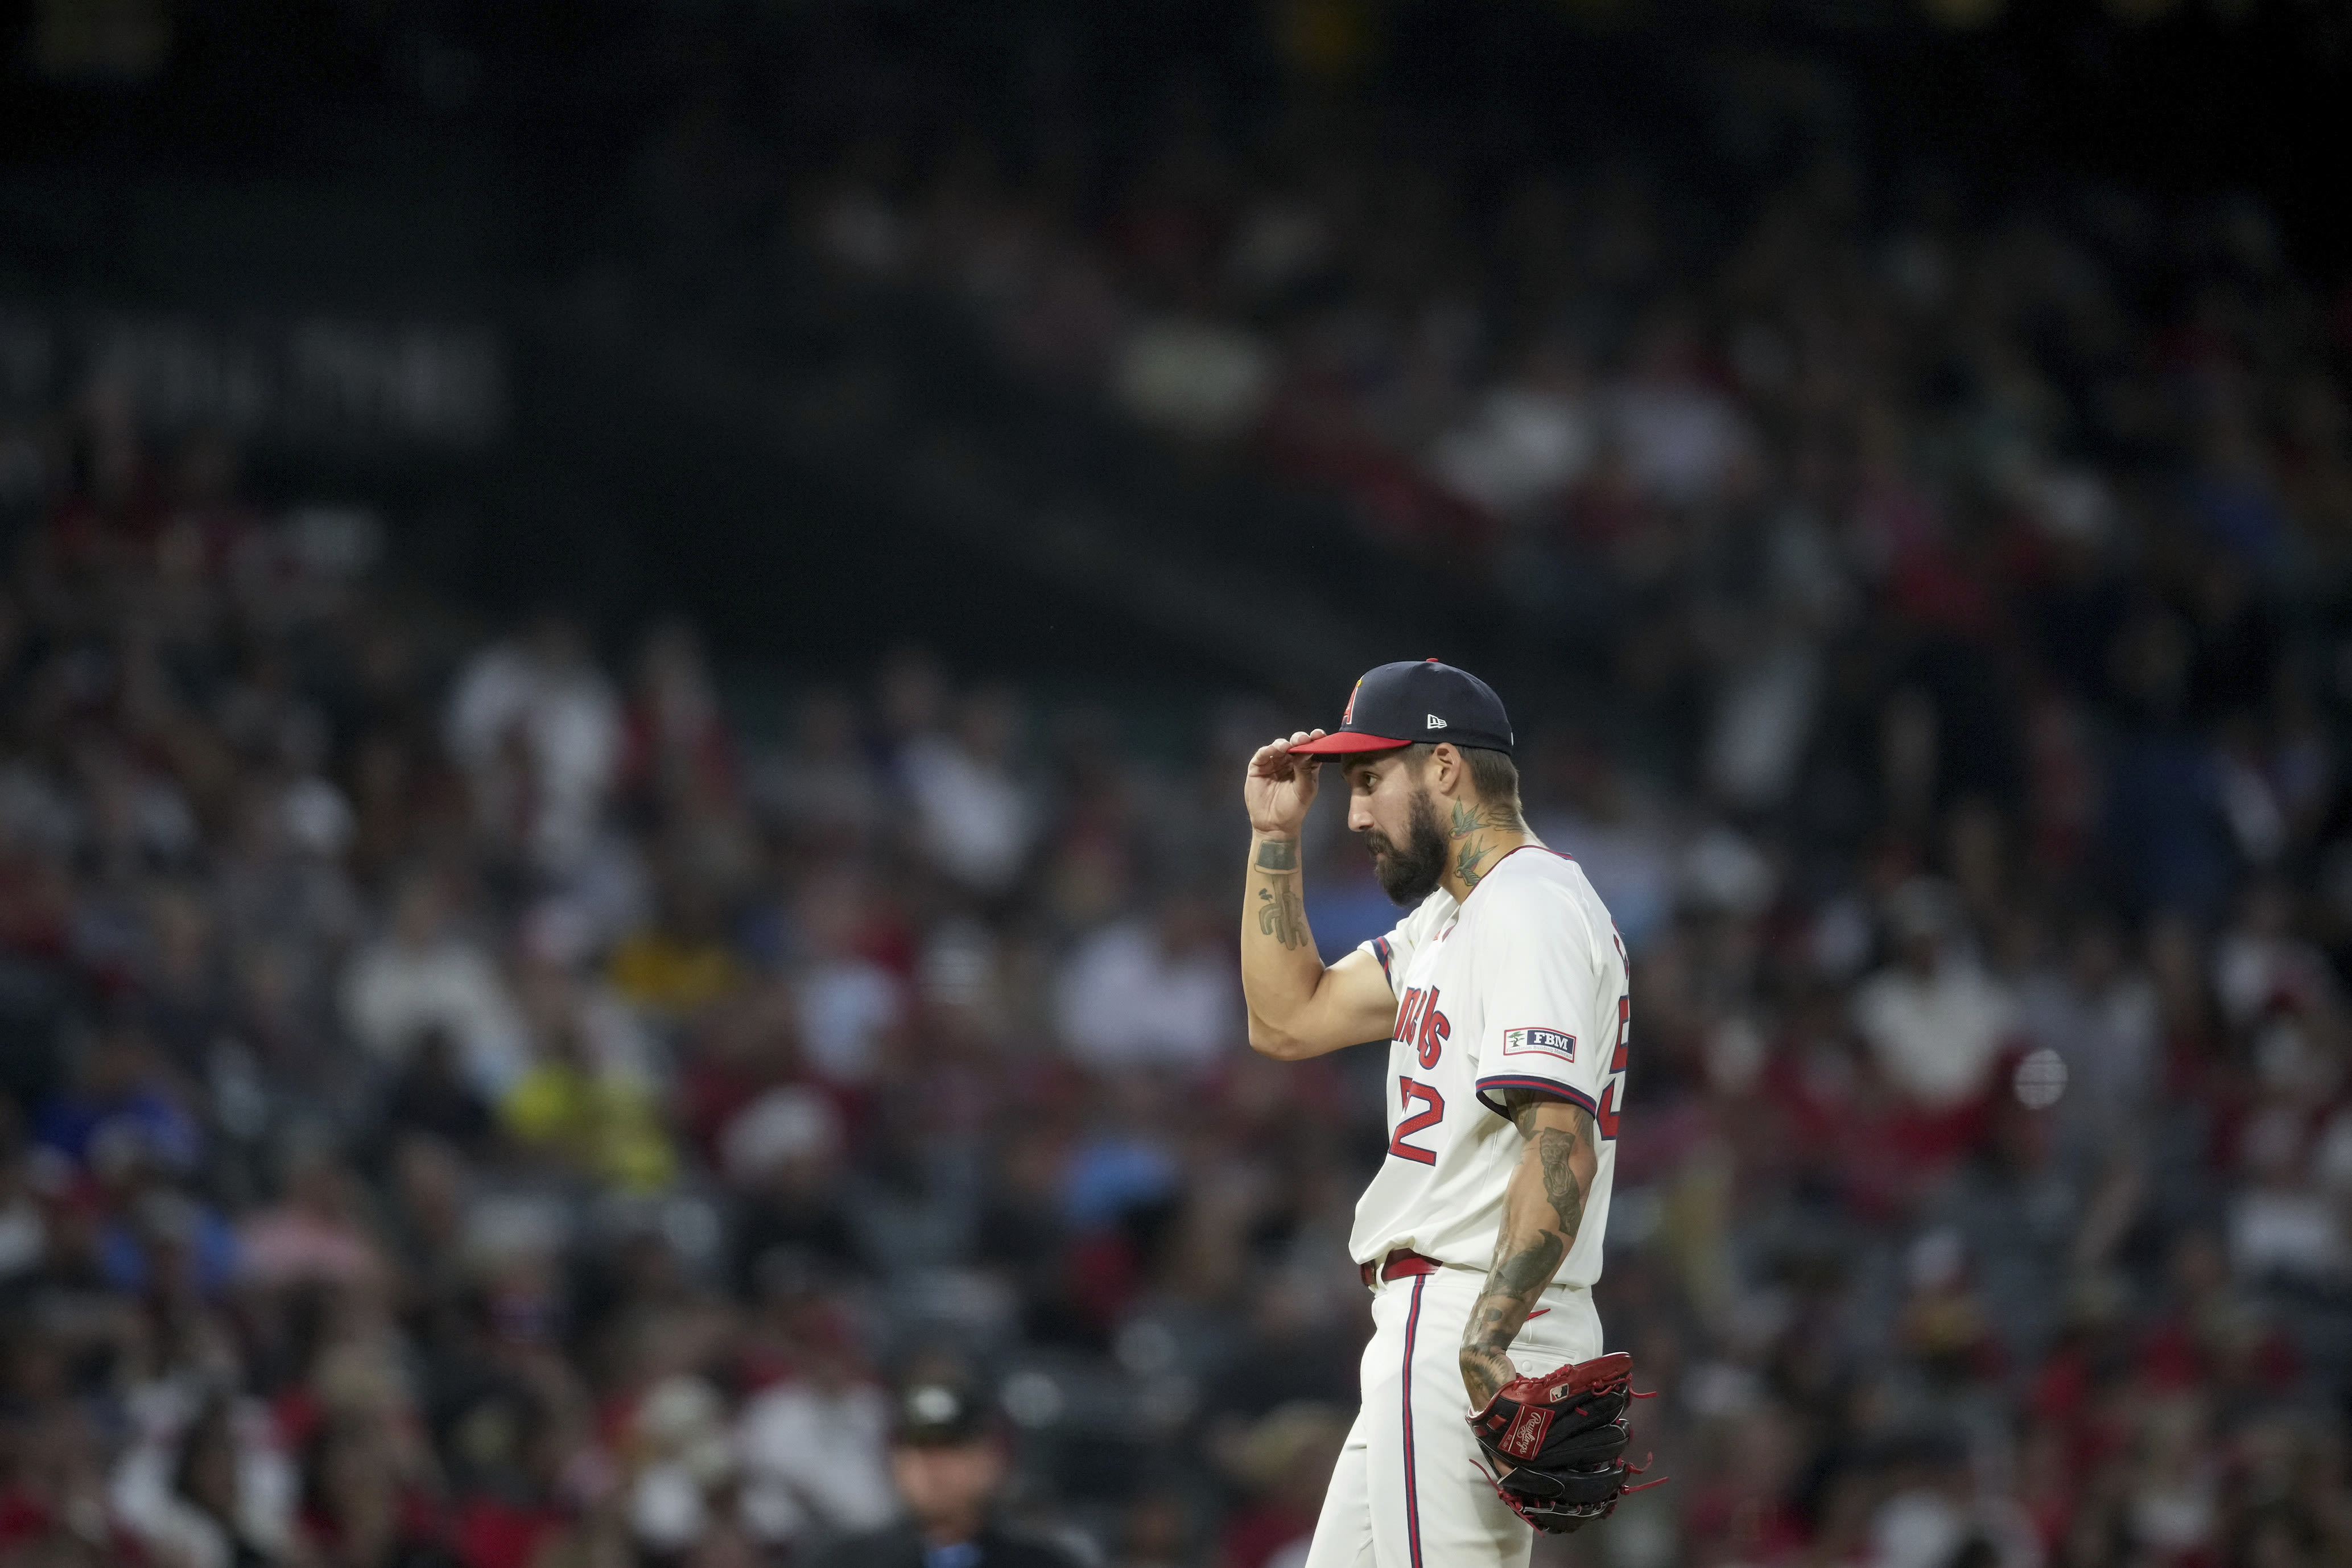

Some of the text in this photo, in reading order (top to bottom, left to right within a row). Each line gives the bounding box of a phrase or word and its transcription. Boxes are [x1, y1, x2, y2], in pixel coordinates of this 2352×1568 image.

[1534, 1032, 1568, 1050] FBM
[1554, 1049, 1572, 1059] Materials
[1516, 1412, 1541, 1454] Rawlings
